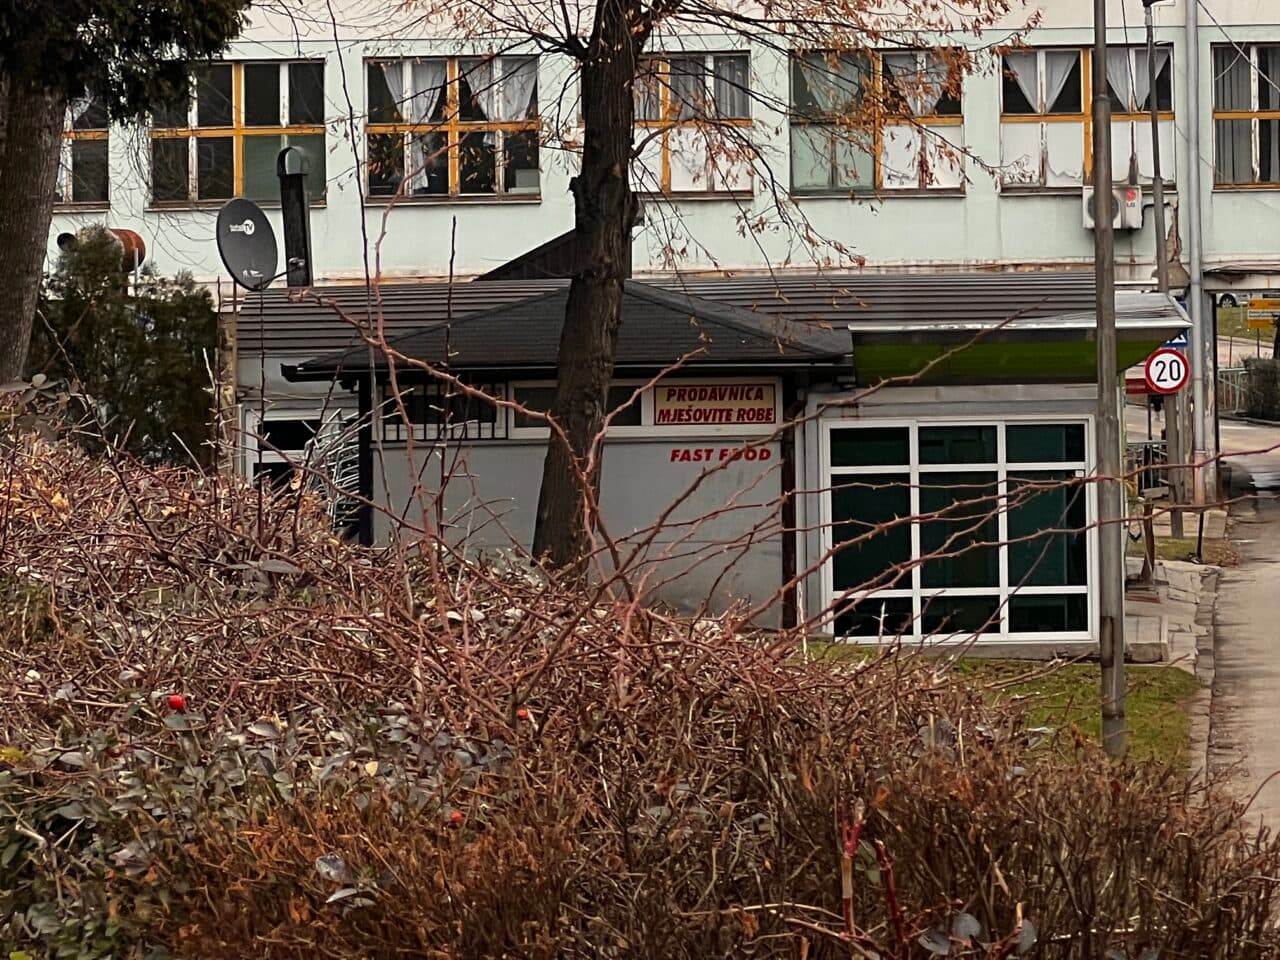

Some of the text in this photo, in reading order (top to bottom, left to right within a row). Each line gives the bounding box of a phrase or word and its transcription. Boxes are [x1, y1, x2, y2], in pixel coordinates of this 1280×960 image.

[1155, 359, 1181, 382] 20
[666, 387, 764, 401] PRODAVNICA
[657, 405, 773, 422] MJEŠOVITE ROBE
[670, 448, 714, 462] FAST
